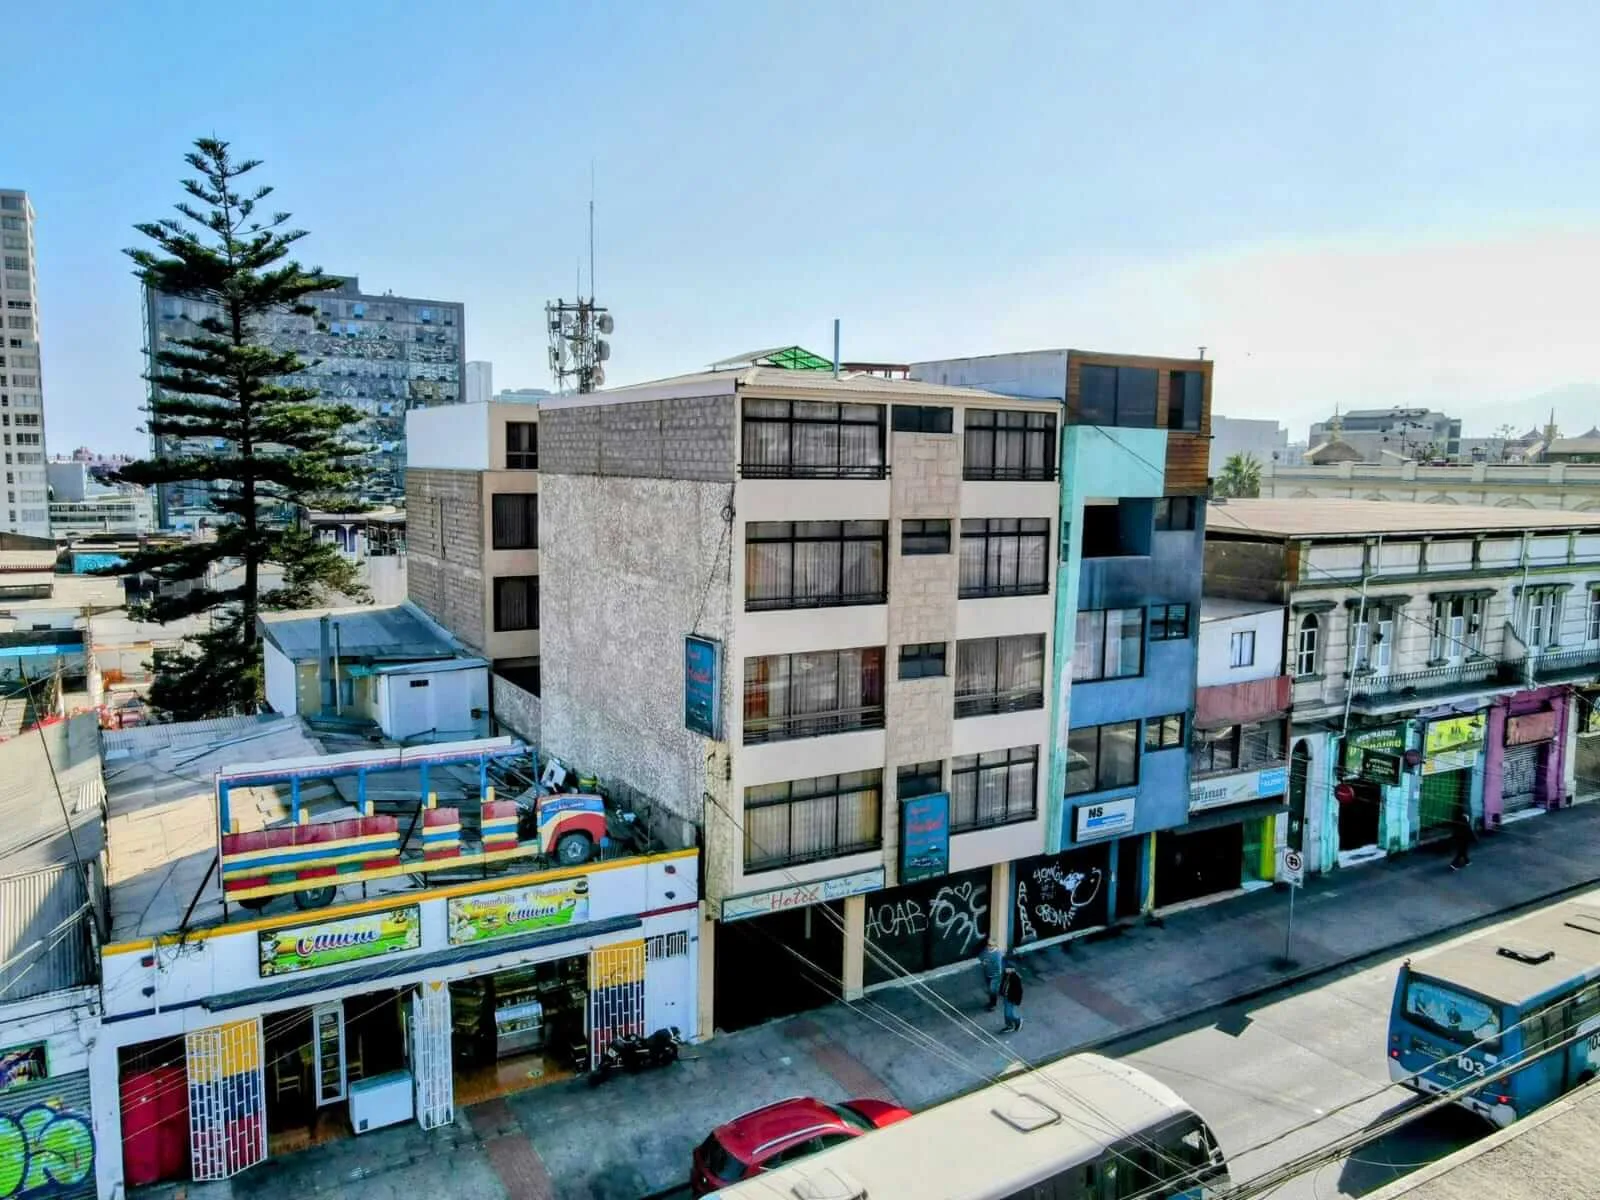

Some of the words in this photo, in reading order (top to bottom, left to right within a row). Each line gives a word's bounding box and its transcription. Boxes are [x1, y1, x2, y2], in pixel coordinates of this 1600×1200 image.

[1088, 807, 1103, 818] NS
[771, 886, 820, 910] Hotel
[1457, 1055, 1485, 1077] 103
